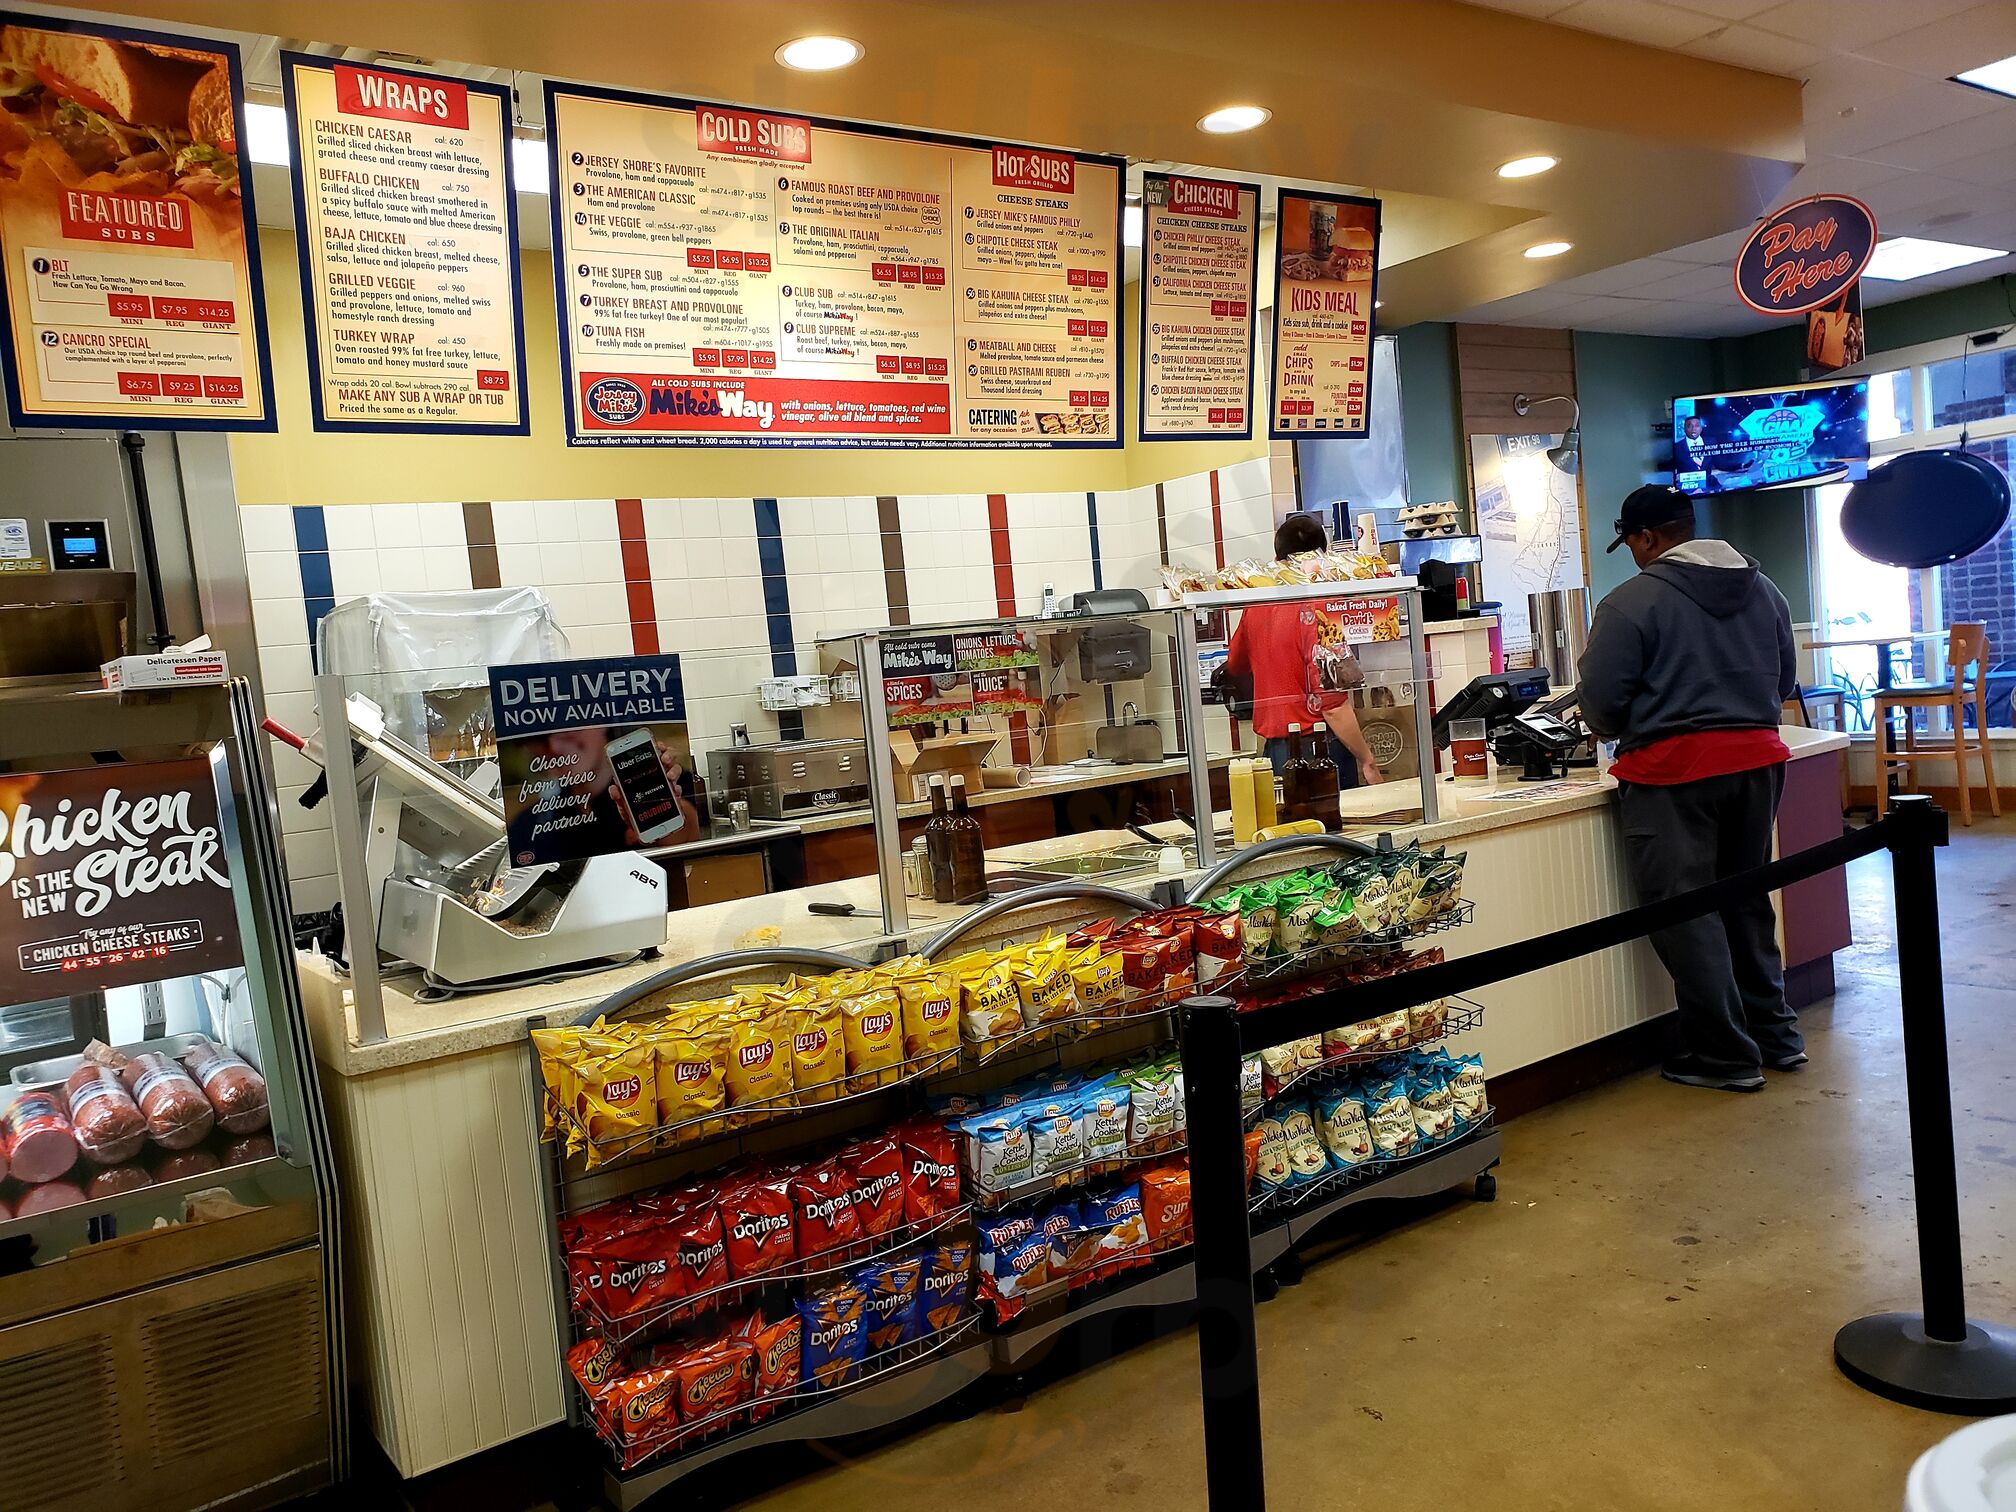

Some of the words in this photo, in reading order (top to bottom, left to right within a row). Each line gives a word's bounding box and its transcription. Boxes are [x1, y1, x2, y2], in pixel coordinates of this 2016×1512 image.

[357, 74, 450, 120] WRAPS
[315, 119, 363, 137] CHICKEN
[367, 126, 411, 143] CAESAR
[701, 111, 751, 145] COLD
[757, 119, 807, 154] SUBS
[317, 134, 345, 147] Grilled
[348, 138, 371, 150] sliced
[374, 142, 404, 154] chicken
[407, 145, 432, 158] breast
[434, 150, 451, 160] with
[453, 151, 481, 165] lettuce,
[585, 155, 619, 168] JERSEY
[622, 159, 661, 173] SHORE'S
[664, 163, 705, 178] FAVORITE
[996, 150, 1026, 178] HOT
[1030, 156, 1070, 186] SUBS
[319, 167, 369, 184] BUFFALO
[373, 174, 419, 190] CHICKEN
[586, 184, 604, 196] THE
[607, 186, 655, 201] AMERICAN
[658, 191, 695, 205] CLASSIC
[791, 178, 825, 193] FAMOUS
[828, 184, 854, 195] ROAST
[857, 186, 874, 197] BEEF
[876, 188, 893, 199] AND
[896, 190, 940, 204] PROVOLONE
[1146, 191, 1161, 204] NEW
[1174, 179, 1232, 209] CHICKEN
[67, 191, 183, 231] FEATURED
[997, 194, 1032, 205] CHEESE
[1035, 198, 1068, 209] STEAKS
[976, 208, 1001, 219] JERSEY
[1003, 211, 1027, 222] MIKE'S
[1029, 214, 1057, 225] FAMOUS
[1059, 216, 1080, 227] PHILLY
[101, 227, 155, 241] SUBS
[324, 226, 355, 240] BAJA
[359, 229, 405, 244] CHICKEN
[1760, 217, 1838, 268] Pay
[51, 259, 68, 272] BLT
[328, 272, 373, 286] GRILLED
[376, 276, 415, 290] VEGGIE
[1763, 251, 1852, 304] Here
[116, 302, 143, 311] $5.95
[161, 304, 187, 314] $7.95
[592, 295, 629, 308] TURKEY
[632, 298, 667, 310] BREAST
[670, 300, 689, 311] AND
[692, 301, 743, 314] PROVOLONE
[1290, 287, 1321, 313] KIDS
[1323, 291, 1359, 315] MEAL
[199, 307, 229, 316] $14.25
[62, 332, 105, 346] CANCRO
[108, 335, 151, 349] SPECIAL
[333, 328, 376, 342] TURKEY
[380, 331, 414, 344] WRAP
[595, 325, 621, 337] TUNA
[624, 326, 644, 337] FISH
[1285, 354, 1313, 369] CHIPS
[126, 380, 152, 389] $6.75
[169, 381, 194, 390] $9.25
[208, 383, 239, 393] $16.25
[483, 376, 504, 384] $8.75
[667, 379, 688, 387] COLD
[690, 380, 710, 388] SUBS
[1283, 372, 1313, 387] DRINK
[338, 388, 370, 401] MAKE
[373, 390, 395, 401] ANY
[399, 390, 420, 402] SUB
[423, 391, 430, 402] A
[432, 392, 465, 403] WRAP
[468, 393, 482, 404] OR
[484, 393, 503, 405] TUB
[594, 390, 637, 403] Jersey
[649, 389, 722, 417] Mike's
[597, 400, 637, 414] Mike's
[968, 409, 1016, 425] CATERING
[1506, 436, 1530, 452] EXIT
[1326, 602, 1347, 612] Baked
[1349, 601, 1367, 610] Fresh
[1369, 599, 1387, 610] Daily!
[1342, 612, 1374, 625] David's
[1348, 626, 1369, 635] Cookies
[956, 636, 985, 650] ONIONS,
[986, 634, 1016, 647] LETTUCE
[146, 657, 198, 666] Delicatessen
[199, 655, 222, 664] Paper
[884, 650, 922, 668] Mike's
[922, 649, 952, 669] Way
[957, 647, 994, 661] TOMATOES
[500, 668, 672, 706] DELIVERY
[887, 684, 923, 702] SPICES
[974, 675, 1008, 692] "JUICE"
[504, 708, 558, 726] NOW
[565, 696, 675, 721] AVAILABLE
[529, 752, 580, 773] Choose
[617, 758, 635, 770] Uber
[636, 752, 652, 764] Eats
[518, 780, 556, 802] from
[558, 770, 596, 786] these
[532, 792, 591, 815] delivery
[814, 791, 837, 801] Classic
[531, 810, 597, 840] partners.
[22, 892, 67, 919] NEW
[72, 826, 232, 917] Steak
[11, 877, 31, 899] IS
[35, 869, 74, 894] THE
[33, 943, 89, 962] CHICKEN
[93, 934, 140, 954] CHEESE
[143, 926, 190, 944] STEAKS
[64, 960, 78, 969] 44
[86, 957, 100, 966] 55
[108, 954, 124, 963] 26
[131, 949, 145, 959] 42
[154, 946, 166, 955] 16
[980, 983, 1018, 1008] BAKED
[1031, 973, 1070, 1003] BAKED
[924, 997, 950, 1019] Lay's
[863, 1013, 894, 1034] Lay's
[796, 1030, 826, 1051] Lay's
[870, 1043, 891, 1053] Classic
[742, 1042, 772, 1064] Lay's
[749, 1072, 773, 1084] Classic
[606, 1076, 638, 1100] Lay's
[1152, 1104, 1174, 1117] Cooked
[1155, 1096, 1173, 1109] Kettle
[616, 1109, 640, 1120] Classic
[1054, 1132, 1076, 1146] Kettle
[1053, 1142, 1080, 1156] Cooked
[912, 1160, 956, 1178] Doritos
[852, 1173, 900, 1204] Doritos
[1106, 1198, 1141, 1221] RUFFLES
[734, 1214, 789, 1240] Doritos
[990, 1218, 1034, 1245] RUFFLES
[610, 1259, 666, 1287] Doritos
[925, 1269, 969, 1291] Doritos
[811, 1320, 858, 1346] Doritos
[688, 1363, 733, 1405] Cheetos
[628, 1380, 672, 1422] Cheetos
